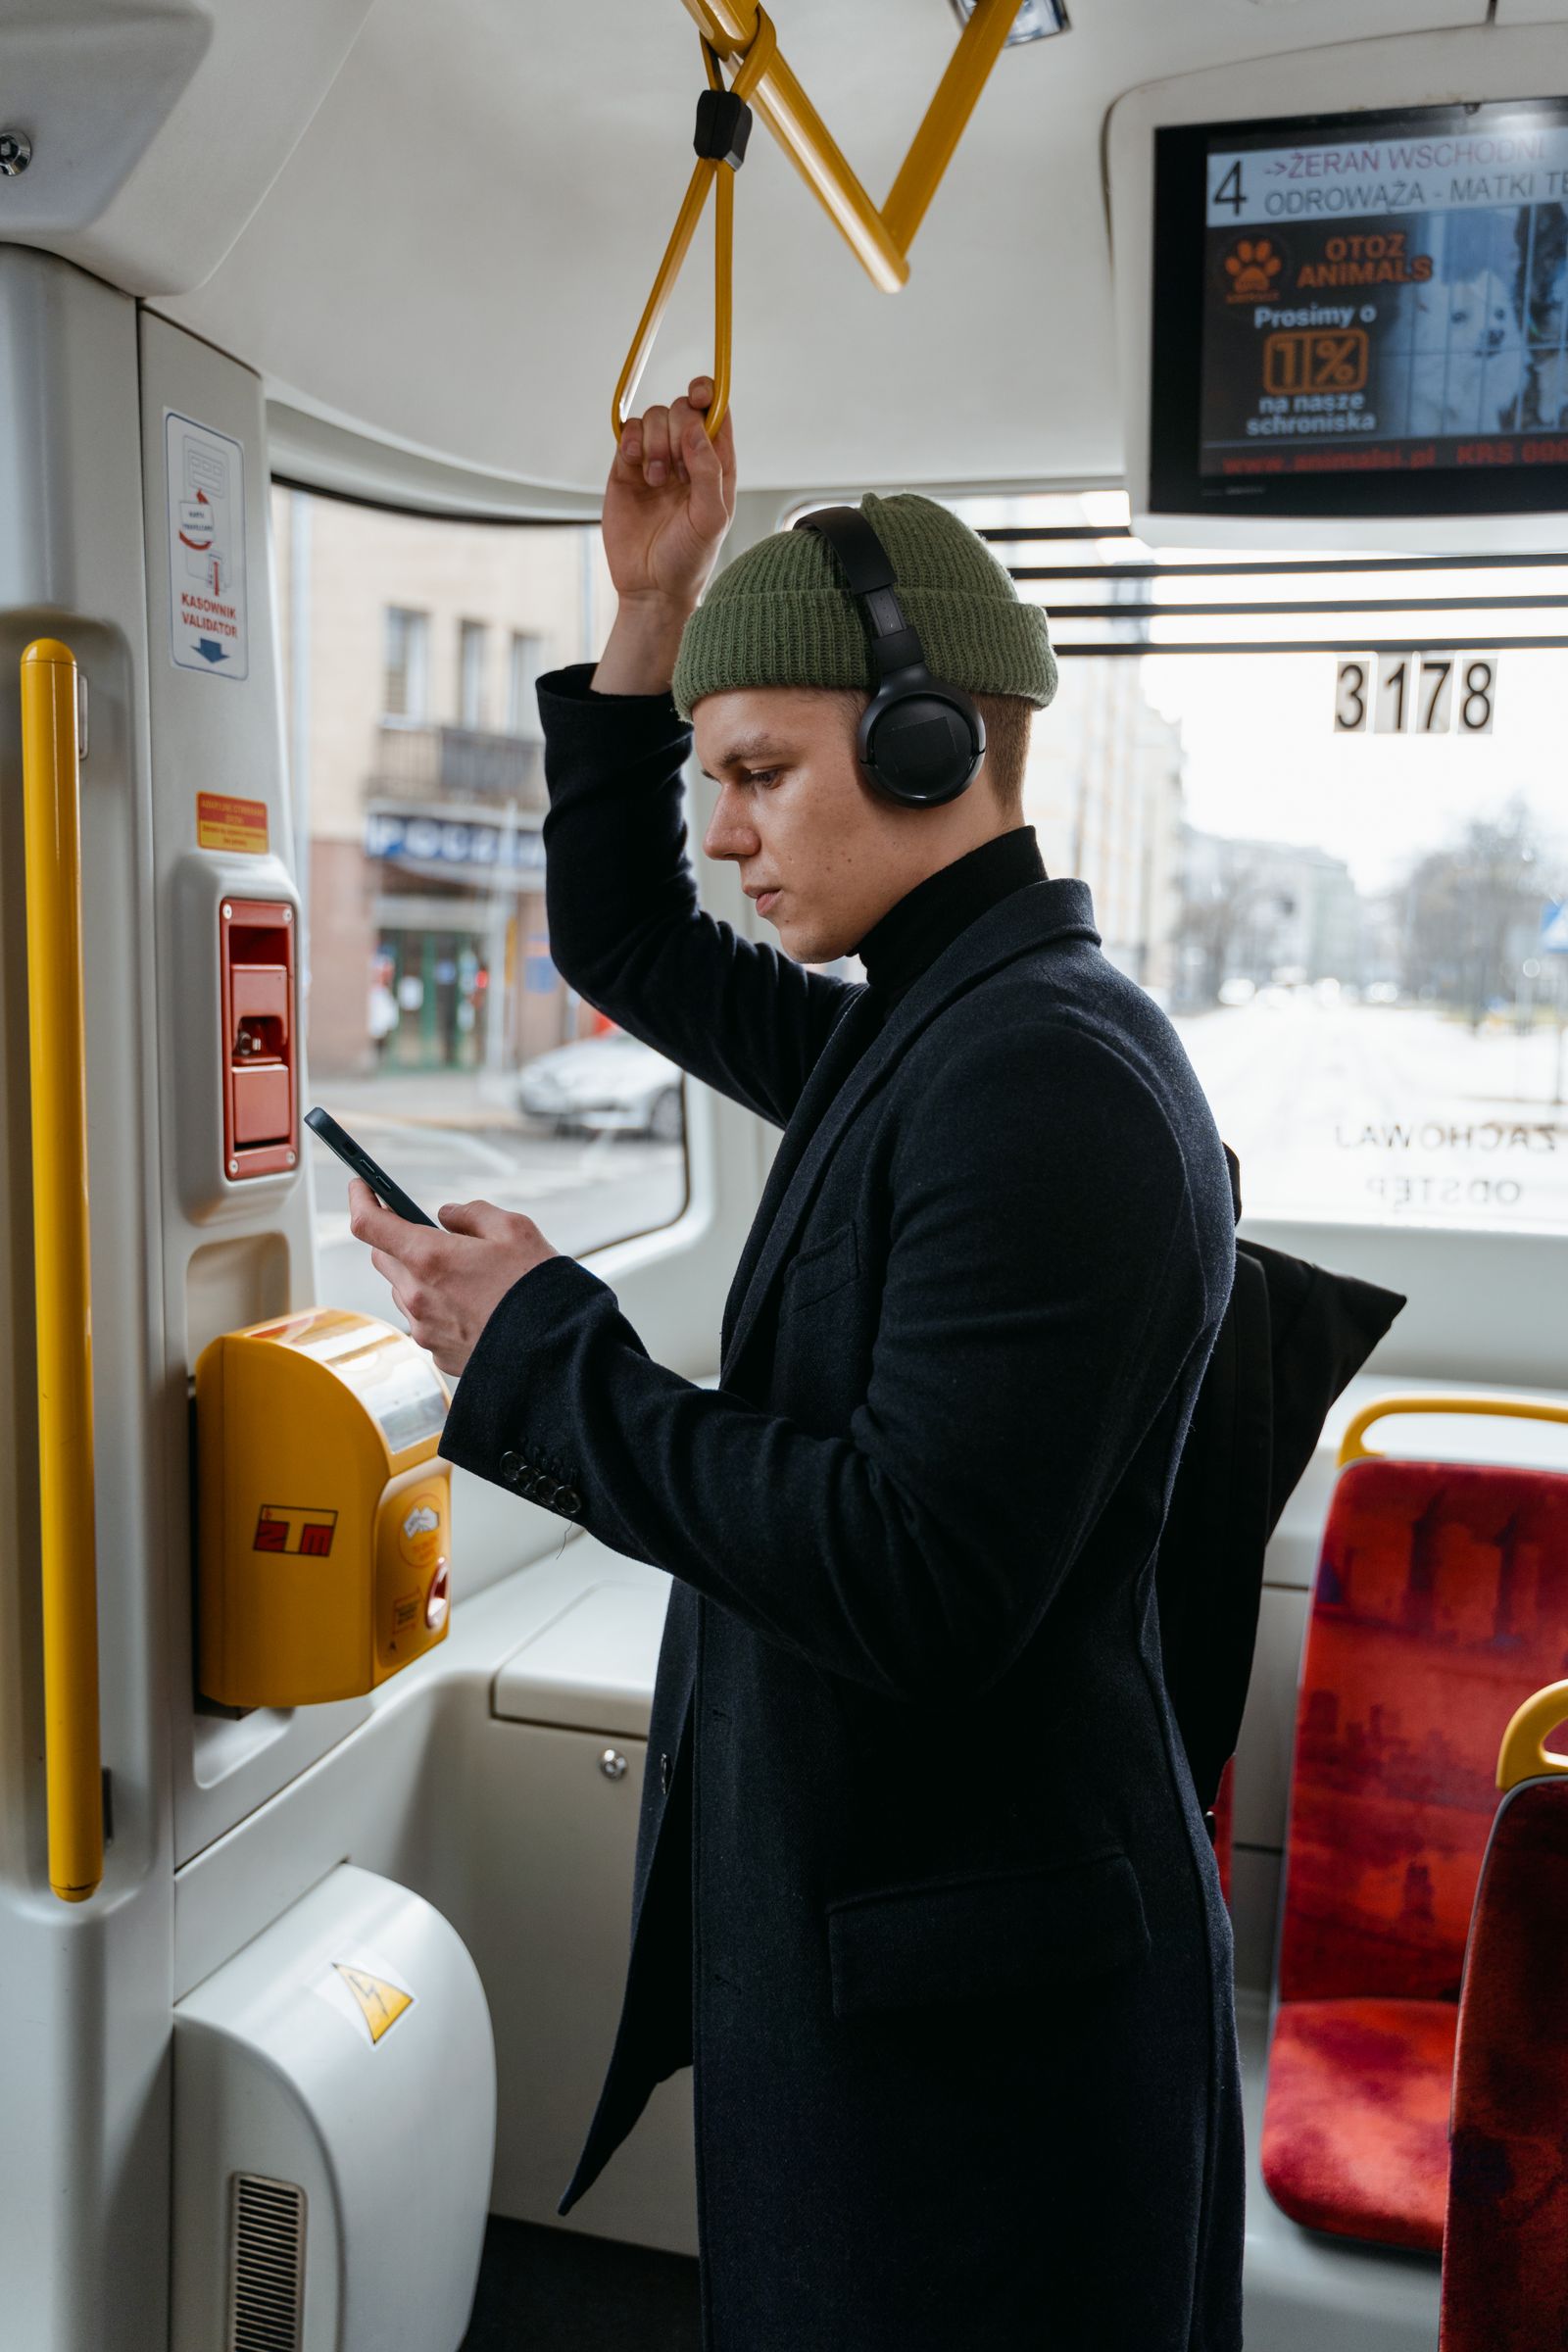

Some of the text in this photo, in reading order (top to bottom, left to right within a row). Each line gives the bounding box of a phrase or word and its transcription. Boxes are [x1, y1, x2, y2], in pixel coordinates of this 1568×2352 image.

[1212, 160, 1248, 217] 4
[1449, 172, 1537, 203] MATKI
[1325, 231, 1406, 262] OTOZ
[1297, 255, 1435, 288] ANIMALS
[1253, 302, 1377, 329] Prosimy o
[1273, 339, 1358, 387] 1%
[1258, 392, 1366, 415] na nasze
[1246, 413, 1377, 436] schroniska
[180, 592, 237, 620] KASOWNIK
[181, 612, 238, 638] VALIDATOR
[1338, 662, 1492, 730] 3178
